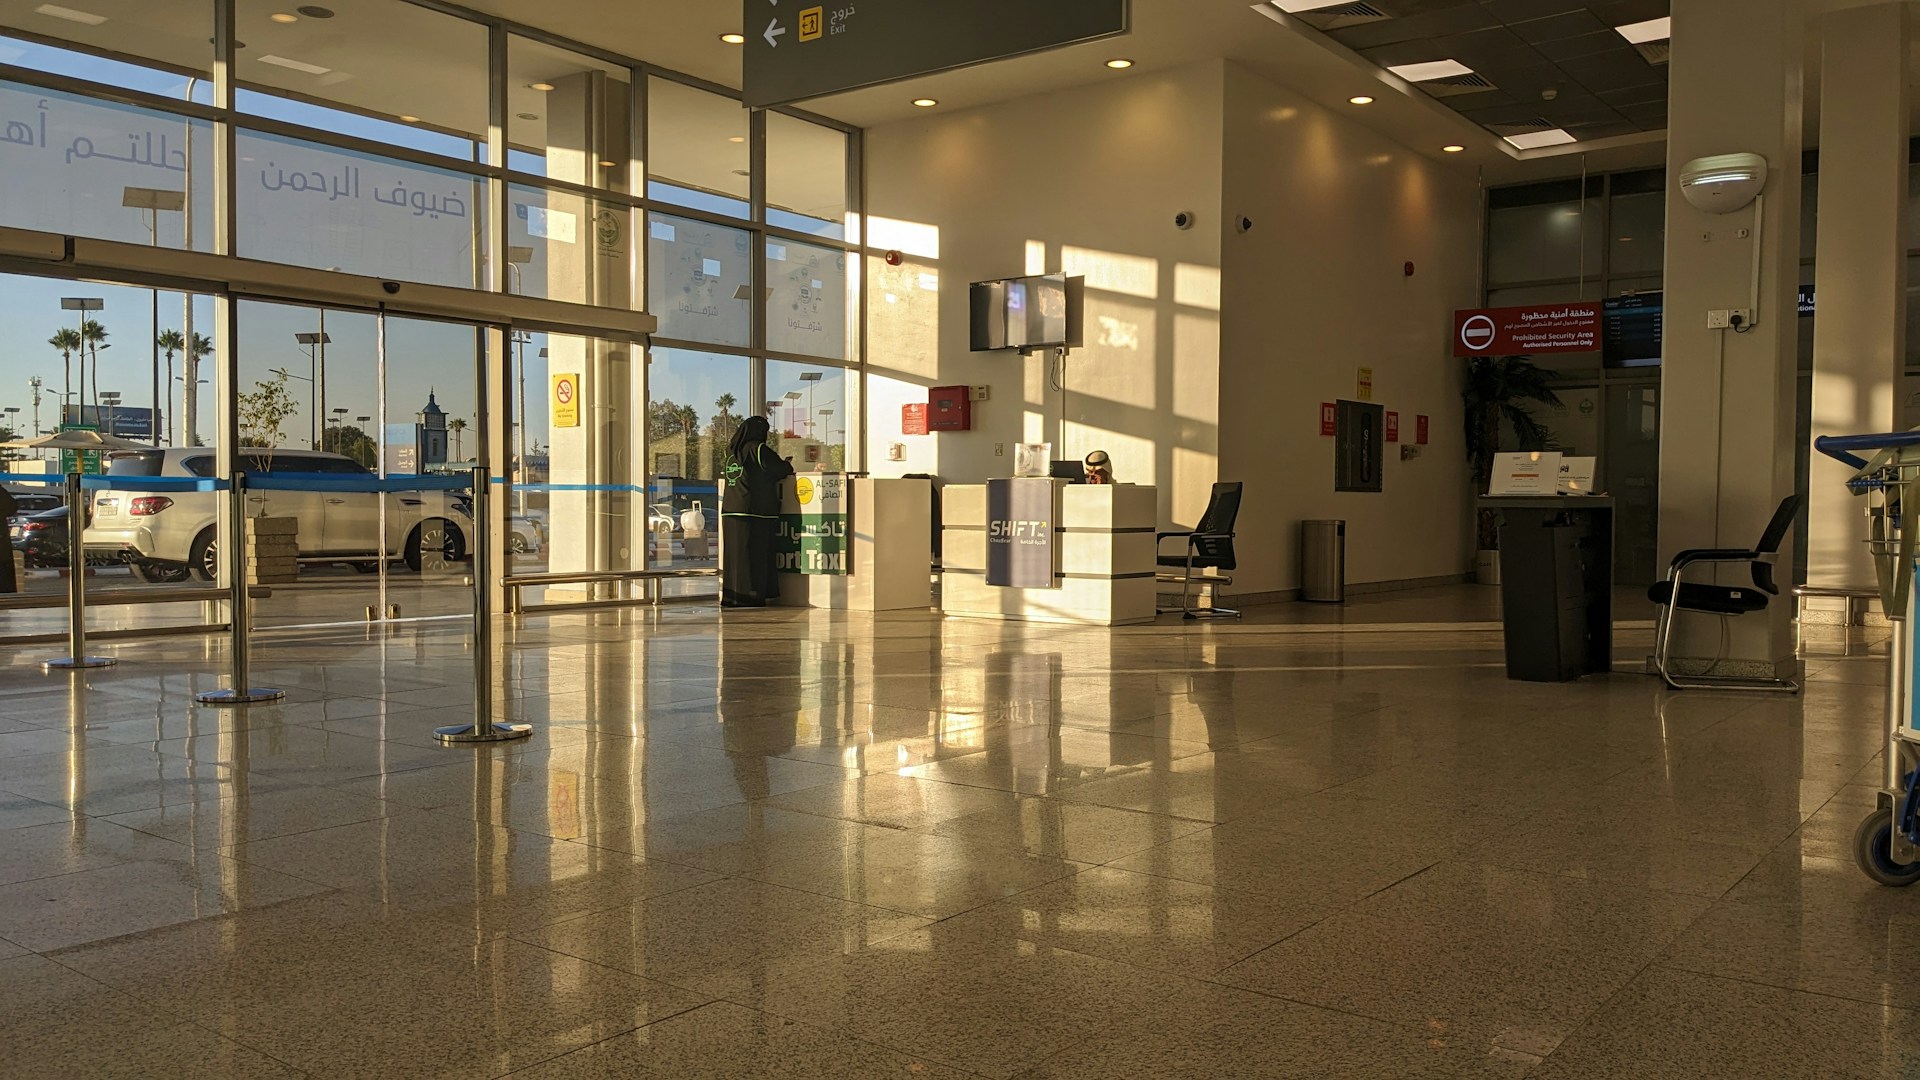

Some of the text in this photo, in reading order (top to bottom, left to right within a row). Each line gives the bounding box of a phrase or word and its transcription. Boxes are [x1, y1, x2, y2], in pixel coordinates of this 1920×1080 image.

[830, 3, 855, 25] خروج
[830, 24, 846, 35] Exit
[0, 99, 49, 148] أه
[261, 161, 359, 202] الرحمن
[374, 180, 466, 220] ضيوف
[1521, 308, 1595, 321] منطقة أمنية محظورة
[1512, 331, 1594, 342] Prohibited Security Area
[1580, 339, 1594, 347] Only
[815, 479, 846, 488] AL-SAFI
[818, 490, 843, 503] الصافي
[775, 521, 845, 544] تاكسي ال
[990, 520, 1040, 537] SHIFT
[775, 549, 846, 570] ort Taxi
